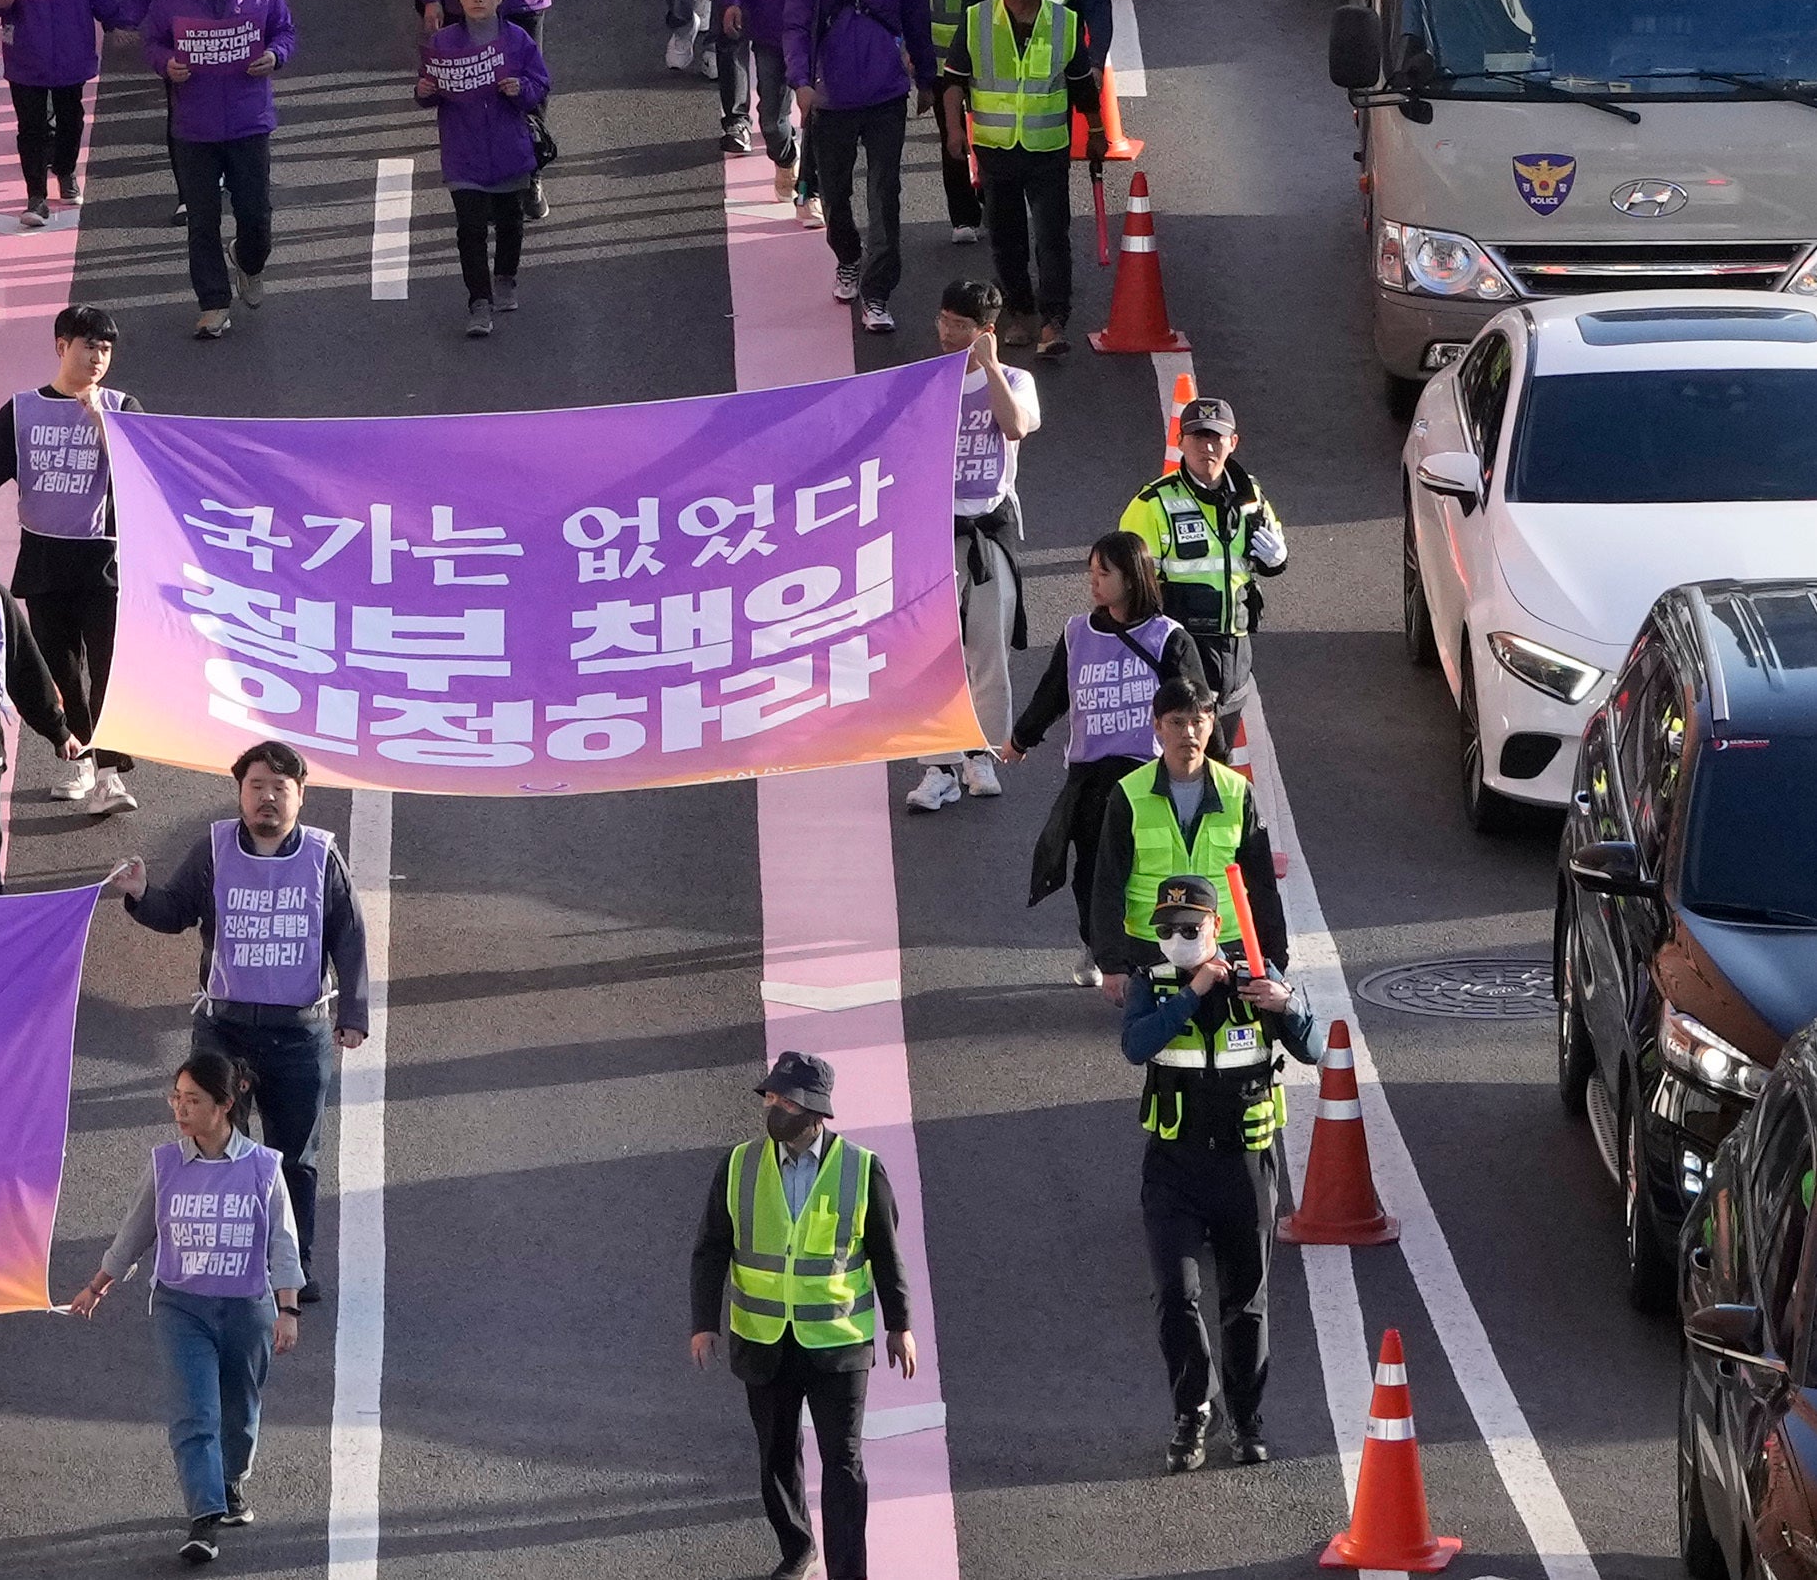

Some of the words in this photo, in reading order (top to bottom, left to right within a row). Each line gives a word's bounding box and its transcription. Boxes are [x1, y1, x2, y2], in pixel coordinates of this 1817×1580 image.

[177, 30, 261, 51] 재발방지대책
[185, 29, 208, 38] 10.29
[189, 47, 250, 65] 마련하라!
[1529, 196, 1560, 206] POLICE
[30, 425, 72, 448] 이태원
[72, 424, 99, 447] 참사
[67, 448, 100, 471] 특별법
[182, 497, 525, 587] 국가는
[561, 456, 895, 584] 없었다
[182, 561, 512, 693] 정부
[569, 531, 895, 675] 책임
[1079, 661, 1120, 686] 이태원
[204, 634, 887, 767] 인정하라
[1075, 687, 1121, 711] 진상규명
[1122, 680, 1155, 706] 특별법
[1086, 705, 1153, 736] 제정하라!
[227, 887, 273, 912] 이태원
[277, 886, 307, 911] 참사
[224, 914, 270, 939] 진상규명
[273, 914, 309, 939] 특별법
[232, 942, 305, 968] 제정하라!
[1230, 1040, 1254, 1049] POLICE
[169, 1194, 220, 1219] 이태원
[223, 1193, 256, 1219] 참사
[170, 1221, 218, 1246] 진상규명
[219, 1220, 255, 1246] 특별법
[179, 1248, 250, 1276] 제정하라!
